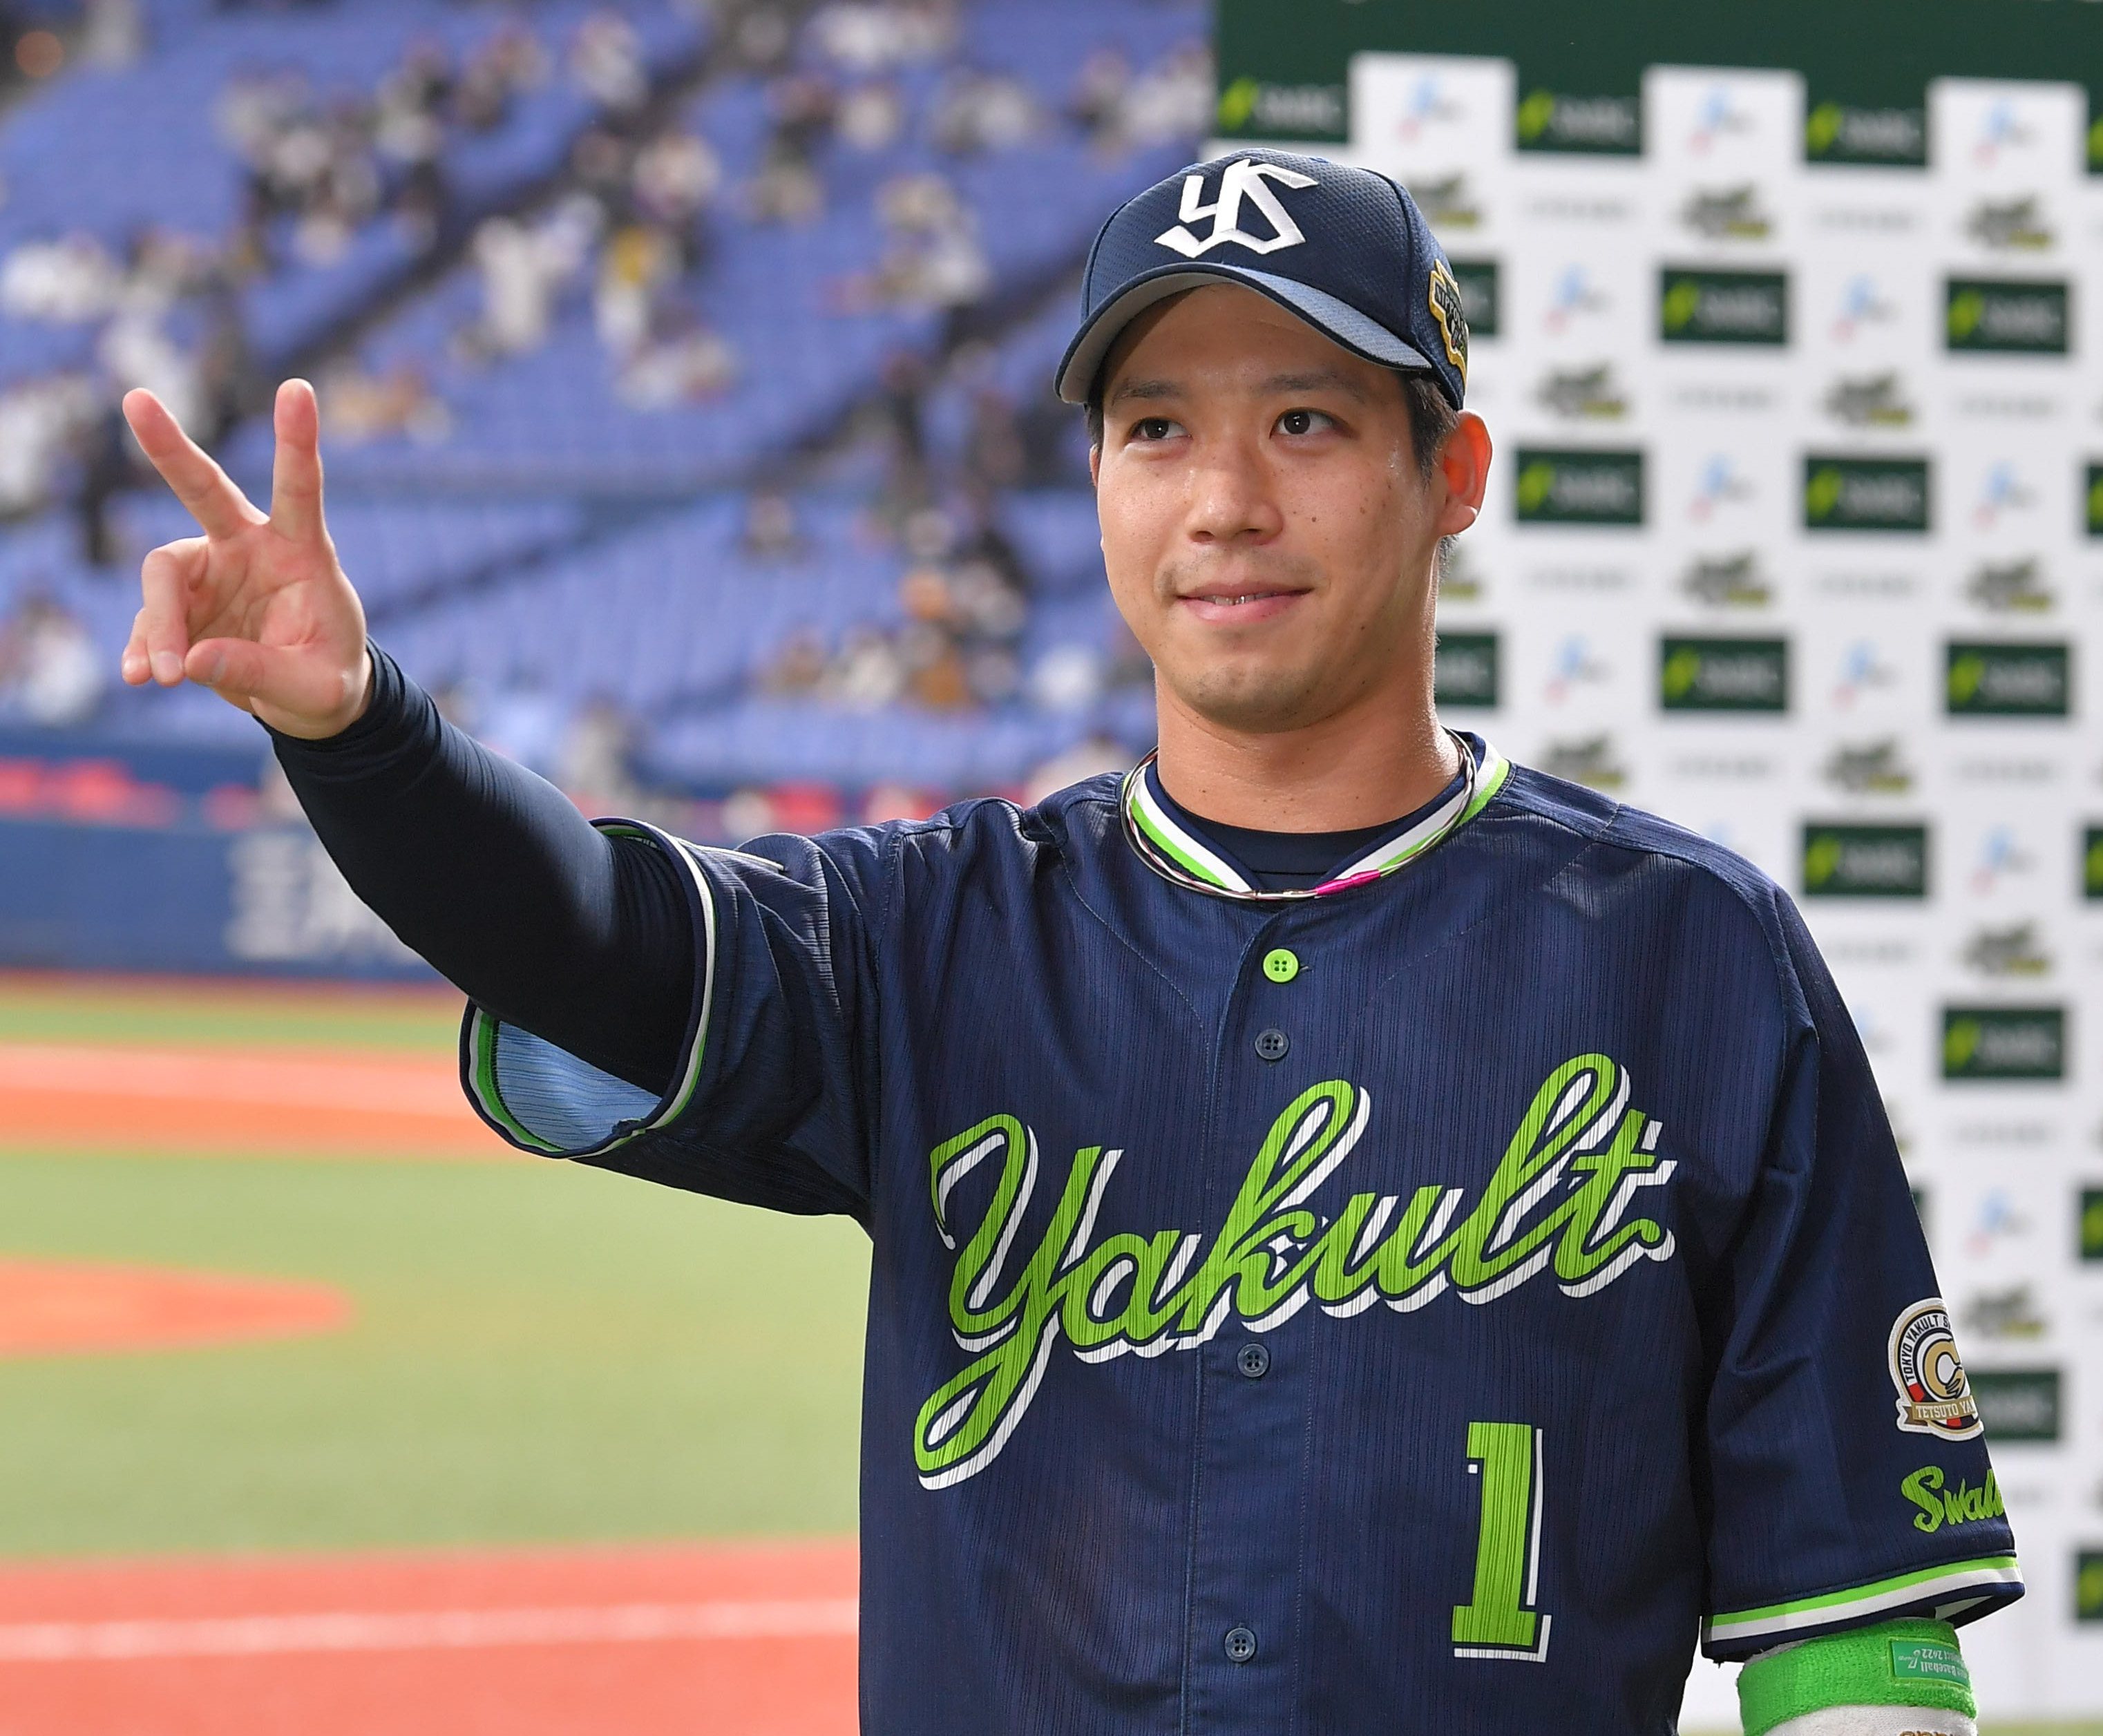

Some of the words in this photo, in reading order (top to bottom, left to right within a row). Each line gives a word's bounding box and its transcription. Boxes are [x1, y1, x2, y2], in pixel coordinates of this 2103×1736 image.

[913, 1052, 1675, 1490] Yakult
[1906, 1315, 1939, 1342] YAKULT
[1901, 1344, 1914, 1382] TOKYO
[1915, 1402, 1959, 1419] TETSUTO
[1452, 1421, 1552, 1662] 1
[1920, 1661, 1957, 1677] Baseball
